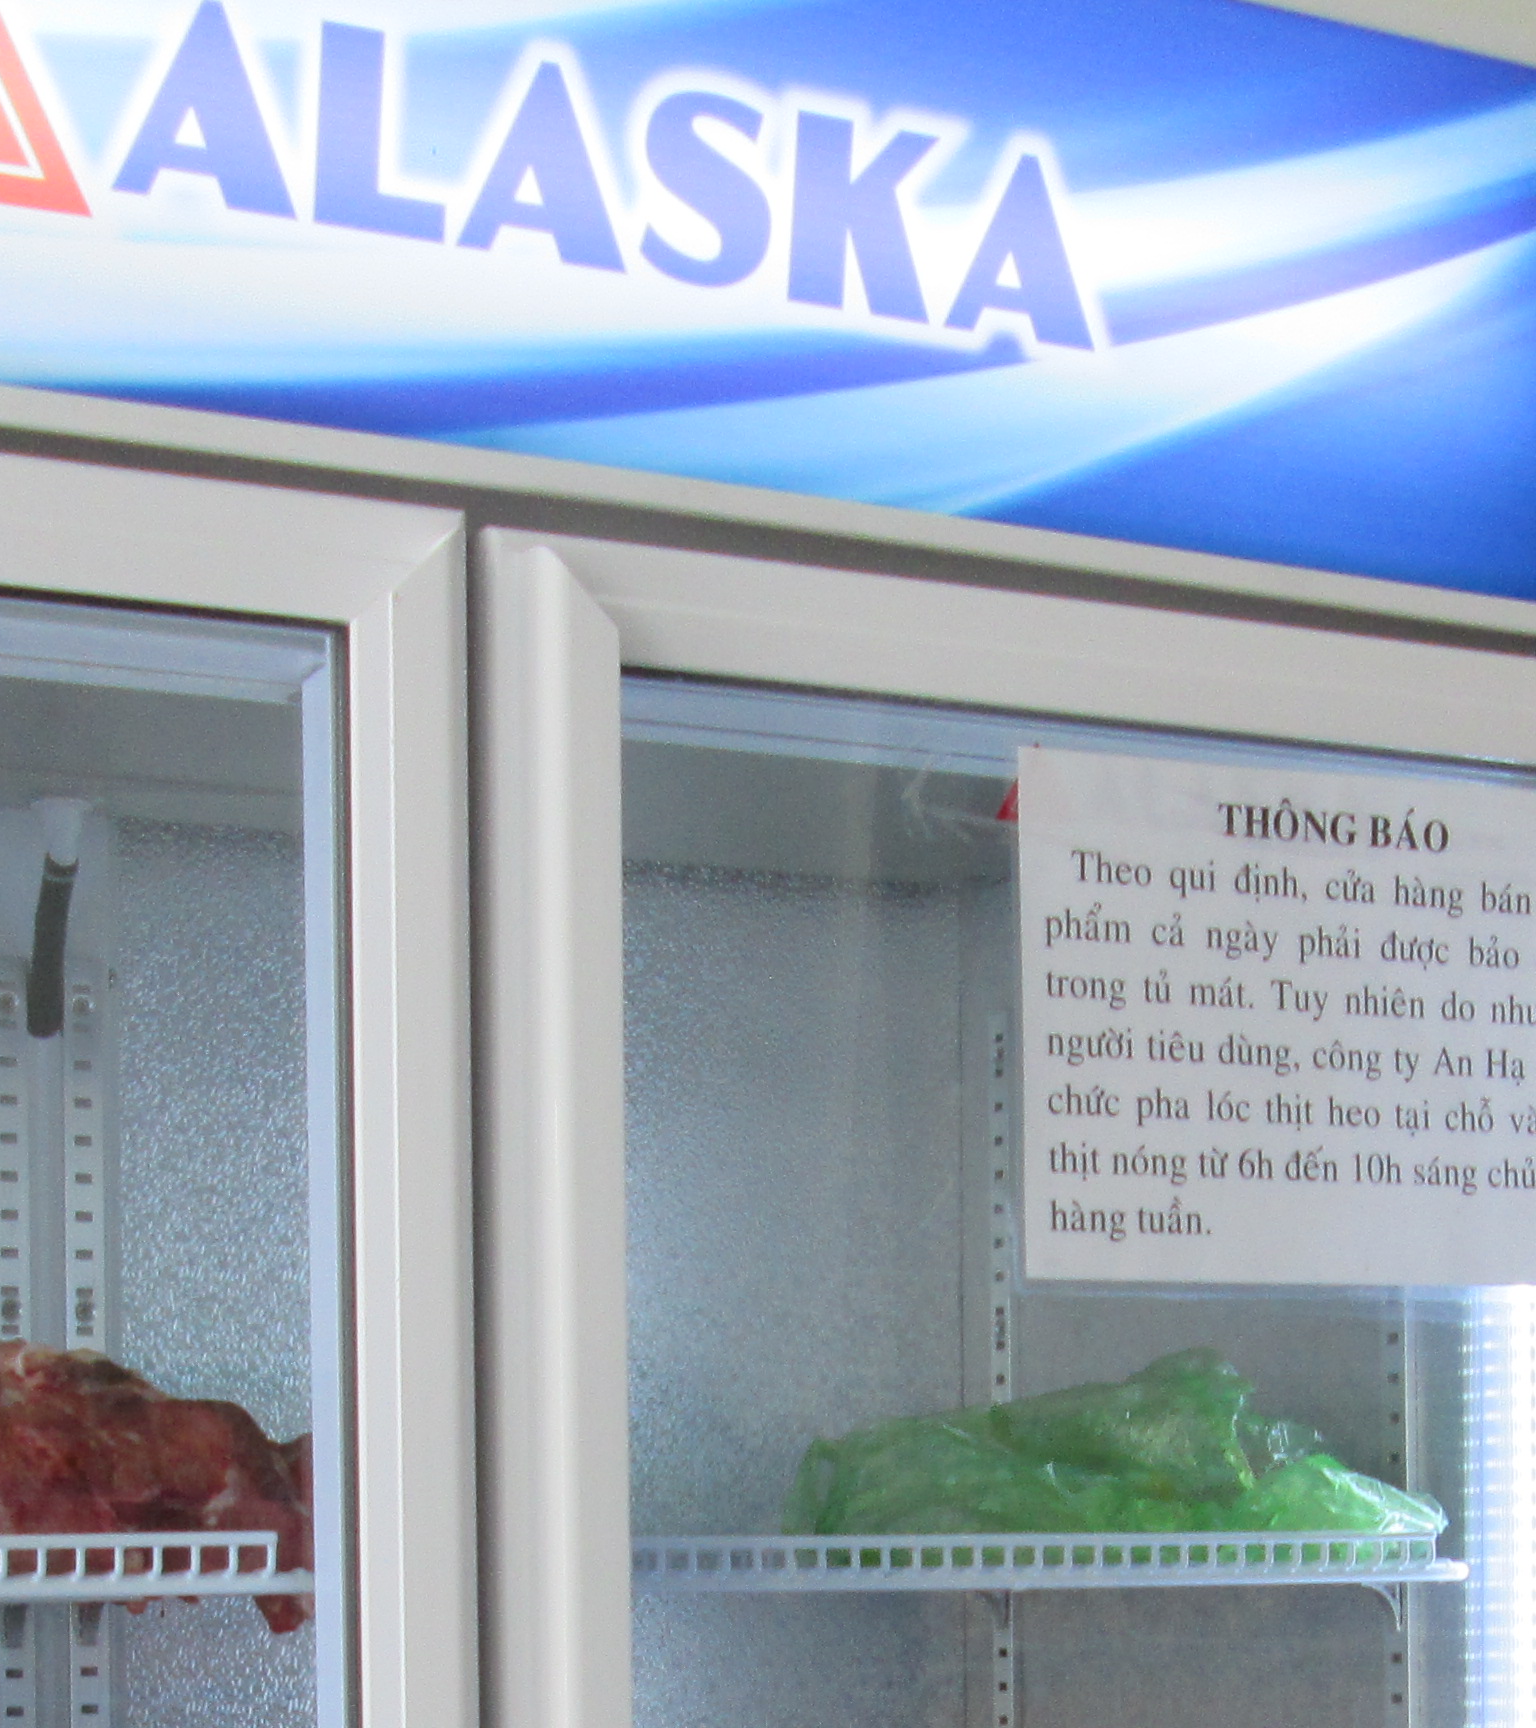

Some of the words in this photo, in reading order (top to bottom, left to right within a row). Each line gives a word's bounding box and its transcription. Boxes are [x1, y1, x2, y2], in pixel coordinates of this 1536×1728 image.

[112, 0, 1094, 350] ALASKA
[1218, 798, 1356, 845] THÔNG
[1370, 808, 1449, 853] BÁO
[1070, 850, 1152, 885] Theo
[1168, 861, 1216, 898] qui
[1233, 864, 1308, 901] định,
[1324, 870, 1375, 903] cửa
[1394, 875, 1464, 918] hàng
[1481, 882, 1531, 915] bán
[1045, 903, 1131, 947] phẩm
[1151, 914, 1185, 947] cả
[1206, 922, 1278, 961] ngày
[1298, 926, 1360, 964] phải
[1379, 931, 1449, 969] được
[1468, 936, 1520, 968] bảo
[1046, 972, 1126, 1010] trong
[1143, 971, 1171, 1003] tủ
[1189, 977, 1254, 1008] mát.
[1270, 980, 1328, 1021] Tuy
[1345, 986, 1425, 1018] nhiên
[1440, 991, 1476, 1020] do
[1047, 1028, 1133, 1066] người
[1147, 1030, 1205, 1063] tiêu
[1217, 1034, 1300, 1076] dùng,
[1312, 1040, 1382, 1080] công
[1394, 1049, 1419, 1082] ty
[1433, 1047, 1473, 1076] An
[1486, 1049, 1525, 1085] Hạ
[1047, 1084, 1120, 1117] chức
[1136, 1088, 1190, 1127] pha
[1207, 1090, 1250, 1122] lóc
[1265, 1093, 1312, 1130] thịt
[1328, 1096, 1381, 1127] heo
[1395, 1101, 1430, 1136] tại
[1444, 1098, 1494, 1132] chỗ
[1049, 1142, 1099, 1180] thịt
[1112, 1146, 1187, 1185] nóng
[1198, 1148, 1229, 1178] từ
[1237, 1149, 1273, 1180] 6h
[1284, 1147, 1338, 1182] đến
[1354, 1154, 1402, 1184] 10h
[1413, 1157, 1477, 1195] sáng
[1487, 1158, 1536, 1189] chủ
[1050, 1200, 1126, 1242] hàng
[1137, 1197, 1211, 1234] tuần.
